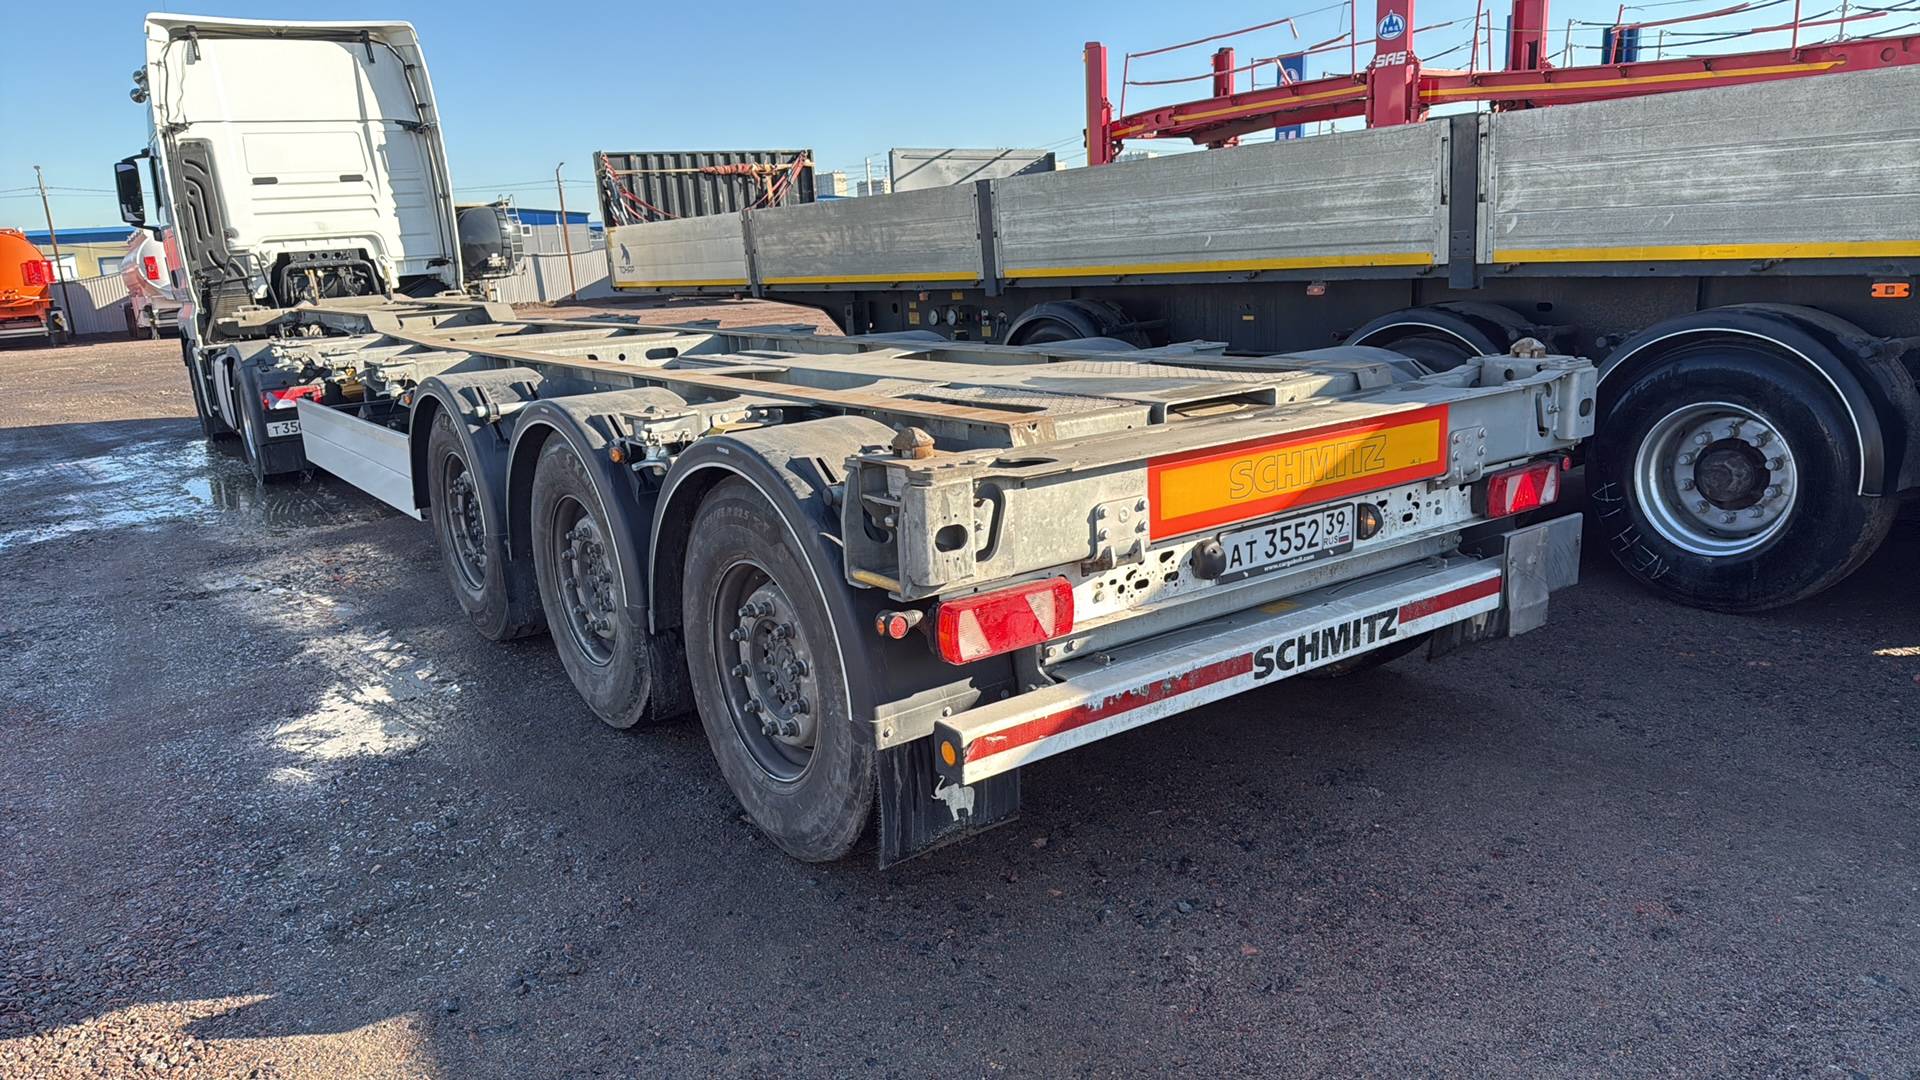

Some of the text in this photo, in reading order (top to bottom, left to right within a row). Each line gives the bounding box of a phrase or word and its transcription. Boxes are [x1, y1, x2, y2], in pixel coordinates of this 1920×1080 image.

[1375, 51, 1407, 68] SAS
[1230, 435, 1387, 498] SCHMITZ
[1264, 519, 1319, 559] 3552
[1325, 511, 1345, 535] 39
[1323, 535, 1338, 546] RUS
[1254, 607, 1398, 680] SCHMITZ
